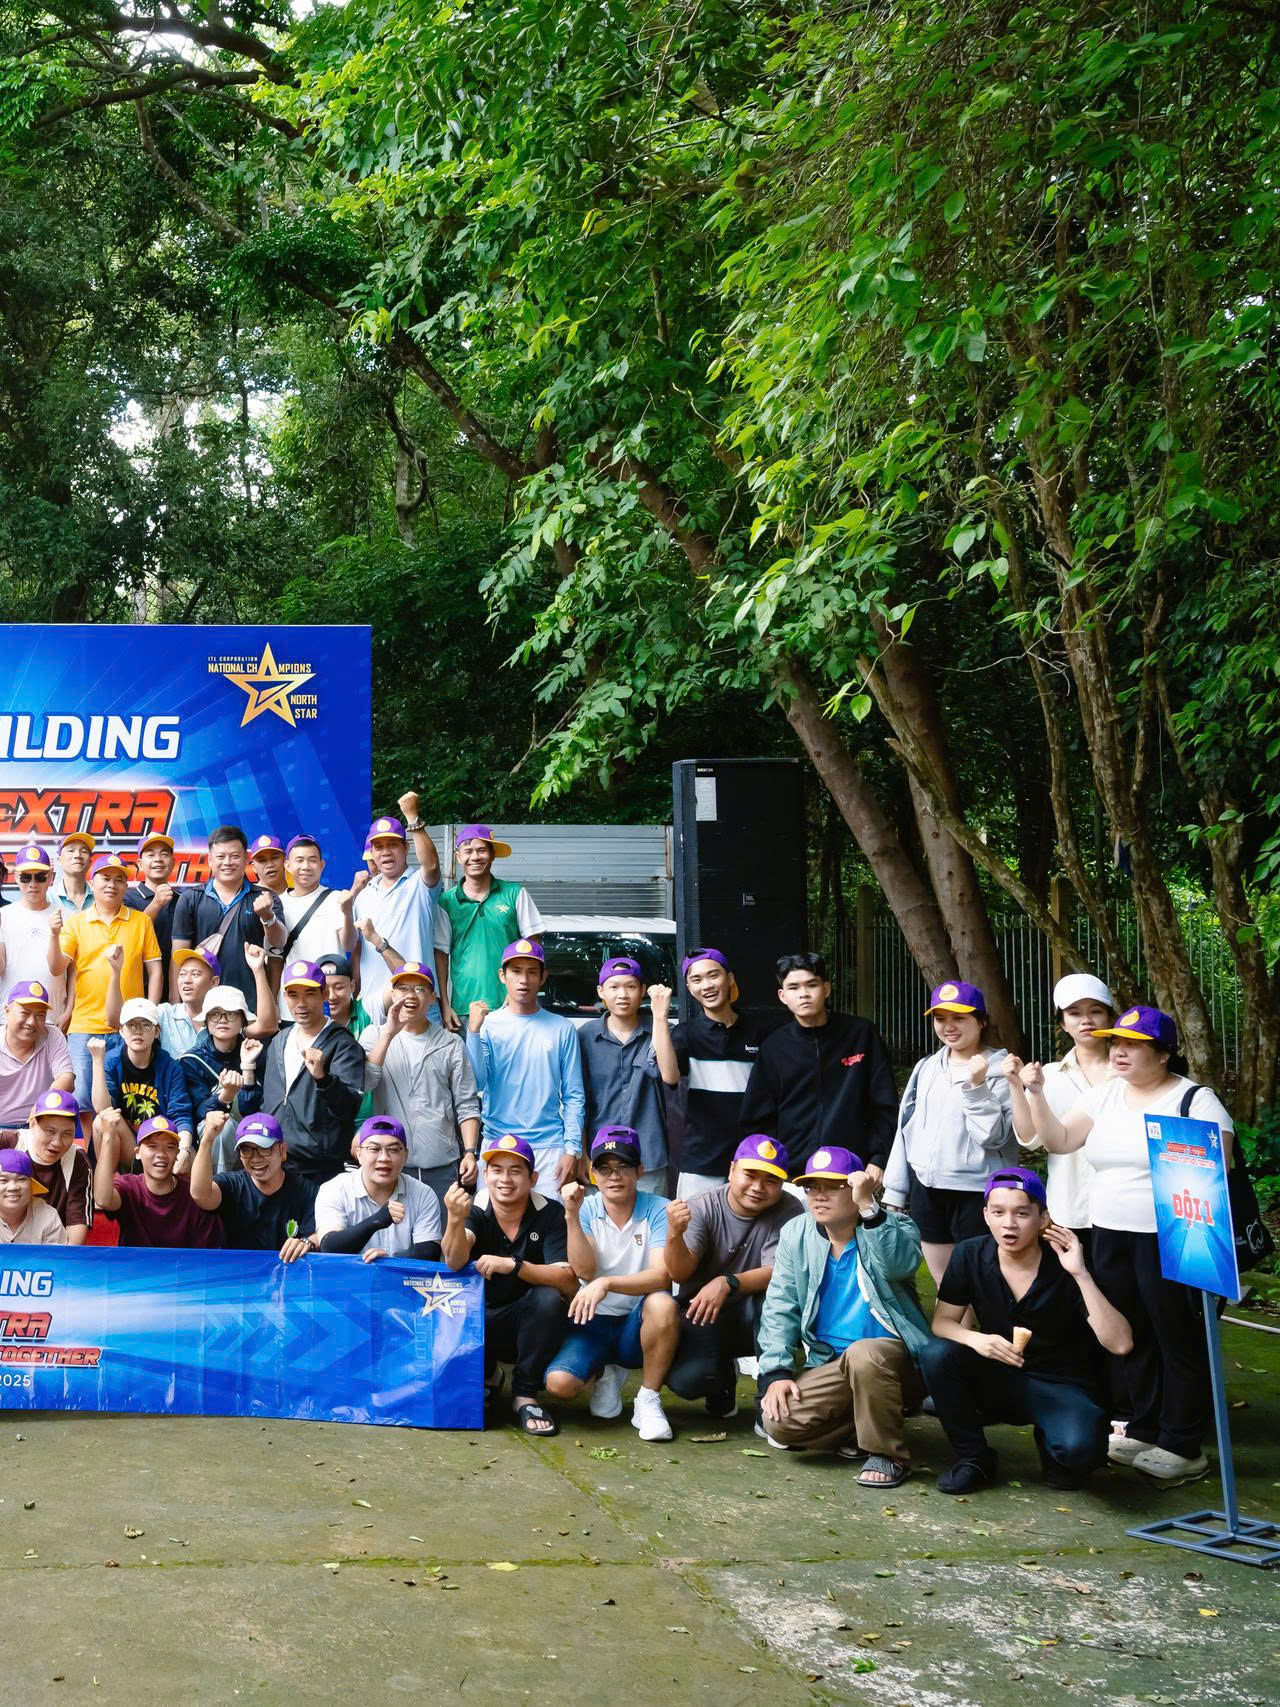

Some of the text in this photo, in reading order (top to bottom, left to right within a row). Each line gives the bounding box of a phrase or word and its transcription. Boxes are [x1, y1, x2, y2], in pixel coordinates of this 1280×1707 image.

[208, 663, 245, 673] NATIONAL
[290, 694, 317, 705] NORTH
[294, 708, 317, 719] STAR
